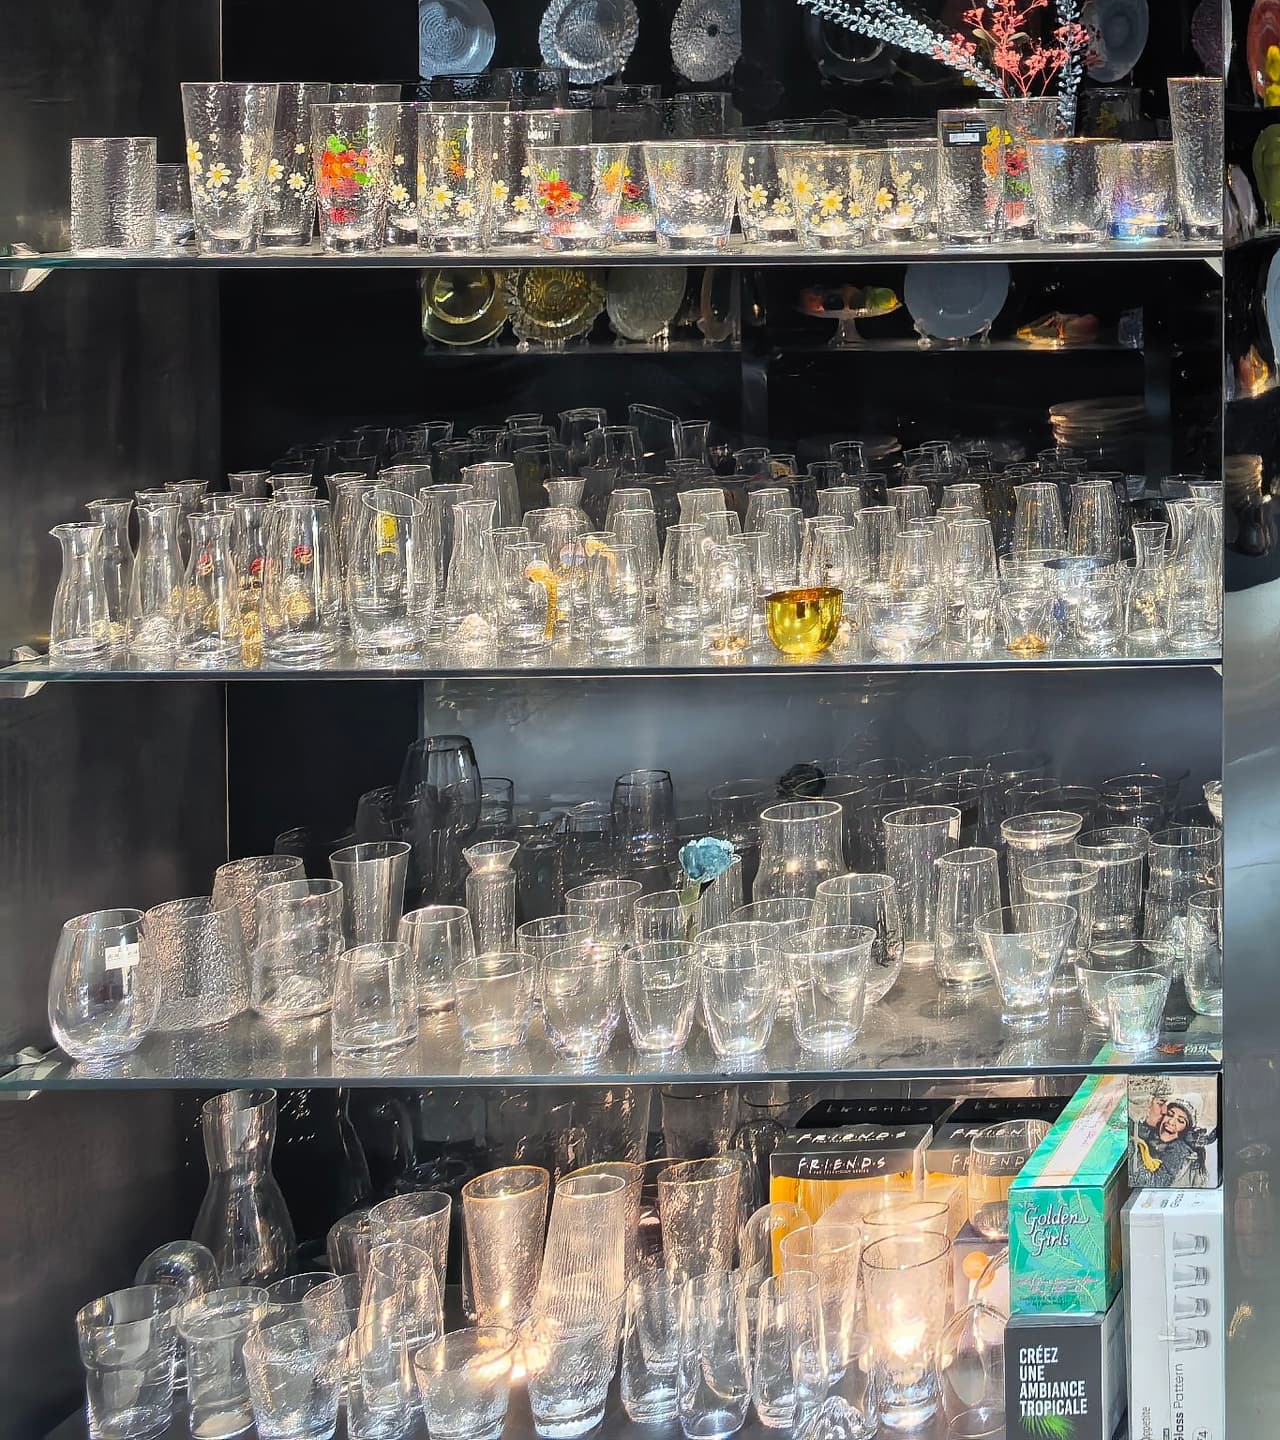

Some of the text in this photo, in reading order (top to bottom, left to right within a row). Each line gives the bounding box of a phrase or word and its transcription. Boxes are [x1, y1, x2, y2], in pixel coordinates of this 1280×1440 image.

[1024, 1203, 1090, 1236] Golden
[1031, 1225, 1071, 1257] Girls
[1019, 1345, 1058, 1364] CRÉEZ
[1019, 1365, 1045, 1382] UNE
[1019, 1381, 1086, 1399] AMBIANCE
[1173, 1363, 1185, 1409] Pattern
[1019, 1399, 1088, 1417] TROPICALE
